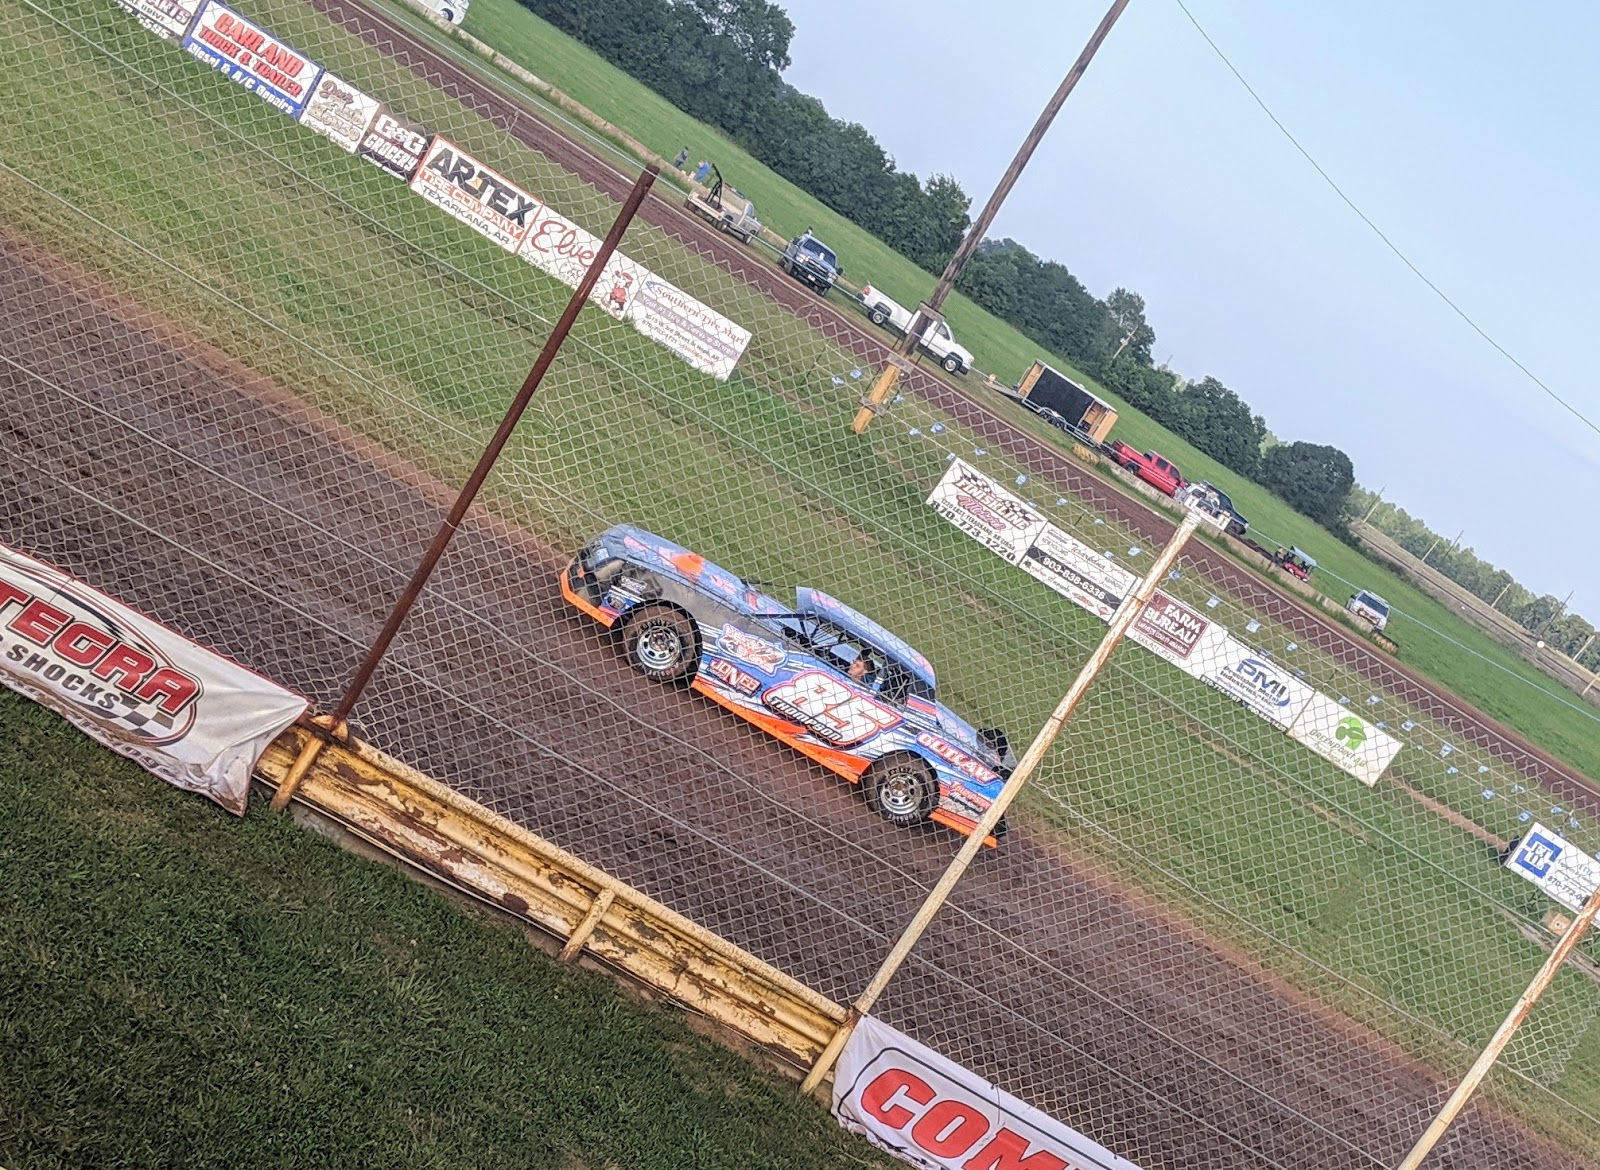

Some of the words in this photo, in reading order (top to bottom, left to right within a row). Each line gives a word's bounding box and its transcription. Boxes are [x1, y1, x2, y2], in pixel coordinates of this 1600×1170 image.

[196, 24, 241, 59] TRUCK
[237, 49, 254, 67] &
[250, 58, 304, 98] TRAILER
[212, 10, 305, 79] GARLAND
[186, 41, 220, 68] Diesel
[219, 62, 232, 75] &
[230, 68, 255, 89] A/C
[254, 83, 296, 115] Repairs
[362, 130, 418, 173] GROCERY
[372, 112, 427, 155] G&G
[420, 169, 453, 194] TIRE
[450, 187, 522, 238] COMPANY
[420, 184, 493, 235] TEXARKANA,
[492, 230, 510, 244] AR
[530, 219, 601, 269] Elve
[654, 286, 700, 317] Southern
[699, 313, 721, 330] Tire
[720, 326, 746, 345] Mart
[928, 499, 1016, 562] 870-773-1220
[1041, 556, 1106, 600] 903-838-6336
[1142, 605, 1196, 645] BUREAU
[1163, 602, 1203, 634] FARM
[8, 644, 122, 709] SHOCKS
[708, 658, 759, 694] JONES
[1222, 665, 1257, 689] Precision
[1256, 686, 1279, 704] Metal
[1235, 659, 1287, 699] PMI
[765, 669, 902, 746] 85
[768, 695, 843, 743] THOMPSON
[917, 732, 997, 783] OUTLAW
[1546, 874, 1586, 903] 870-772-00
[861, 1068, 1083, 1170] COM
